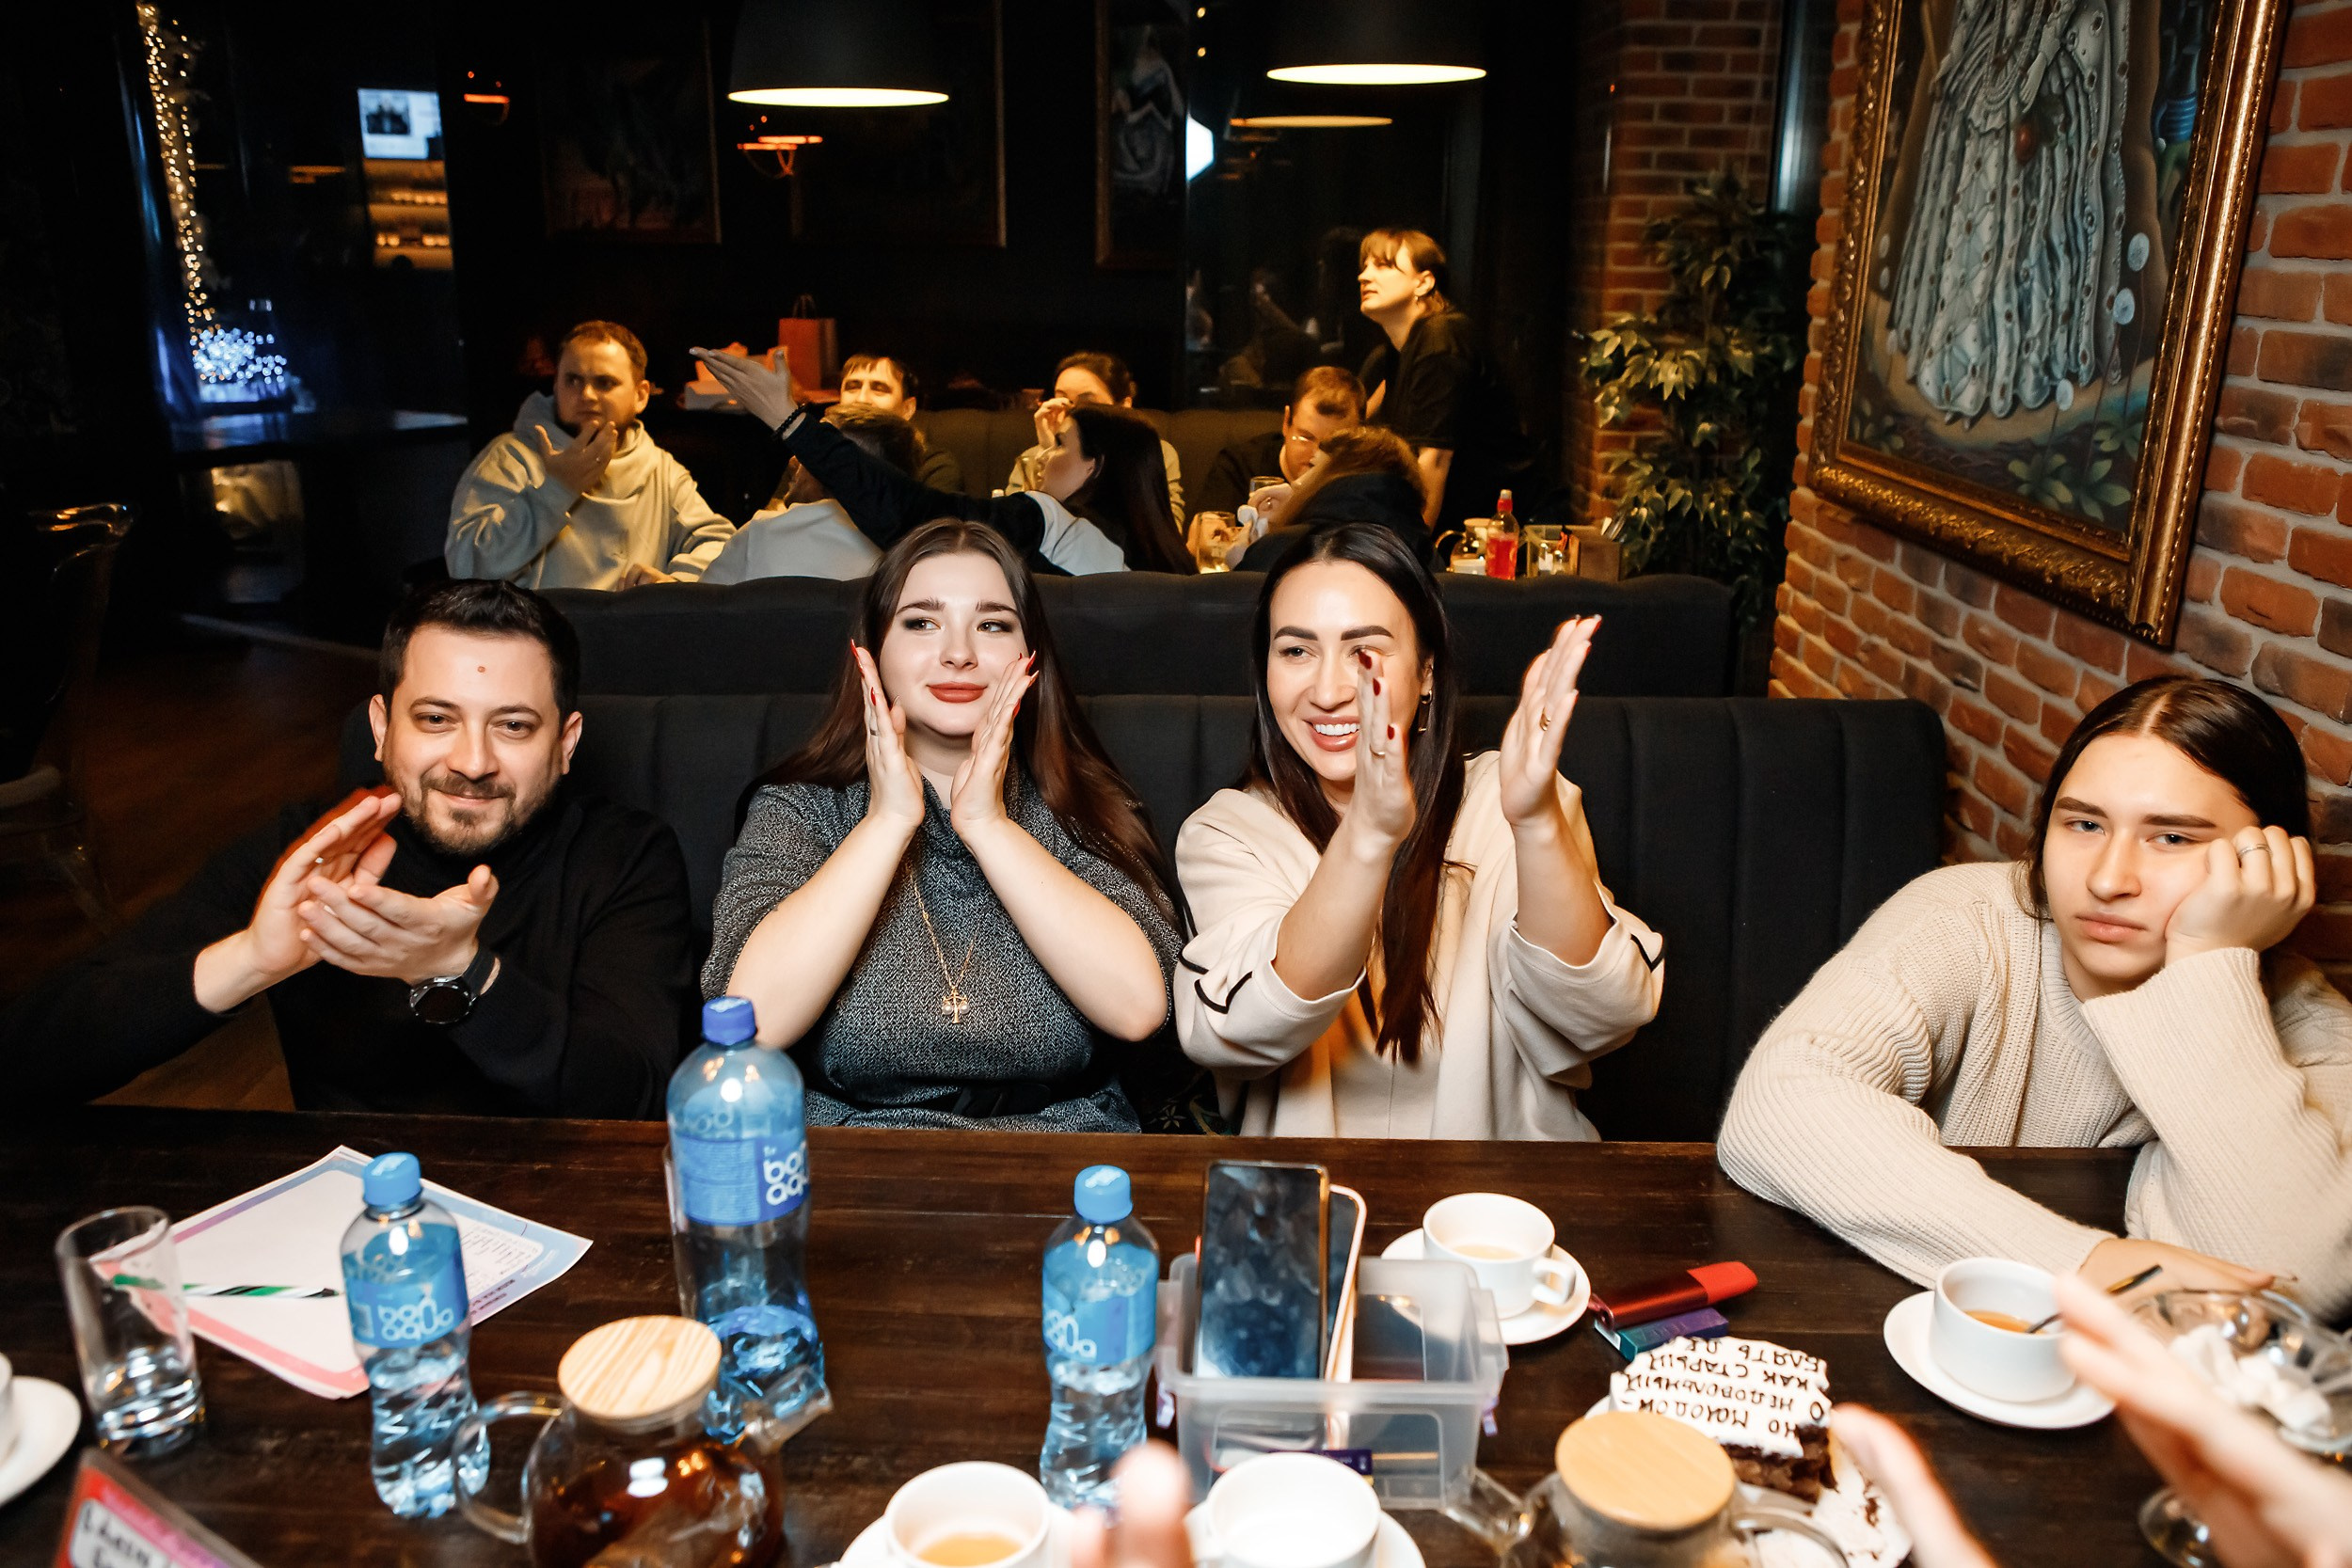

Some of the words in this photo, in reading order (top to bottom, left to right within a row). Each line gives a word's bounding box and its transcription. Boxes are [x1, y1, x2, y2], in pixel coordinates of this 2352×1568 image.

[1682, 1338, 1722, 1354] ДЕ
[1647, 1353, 1749, 1379] СТАРЫЙ
[1738, 1344, 1820, 1373] БЛЯТЬ
[1762, 1370, 1808, 1392] КАК
